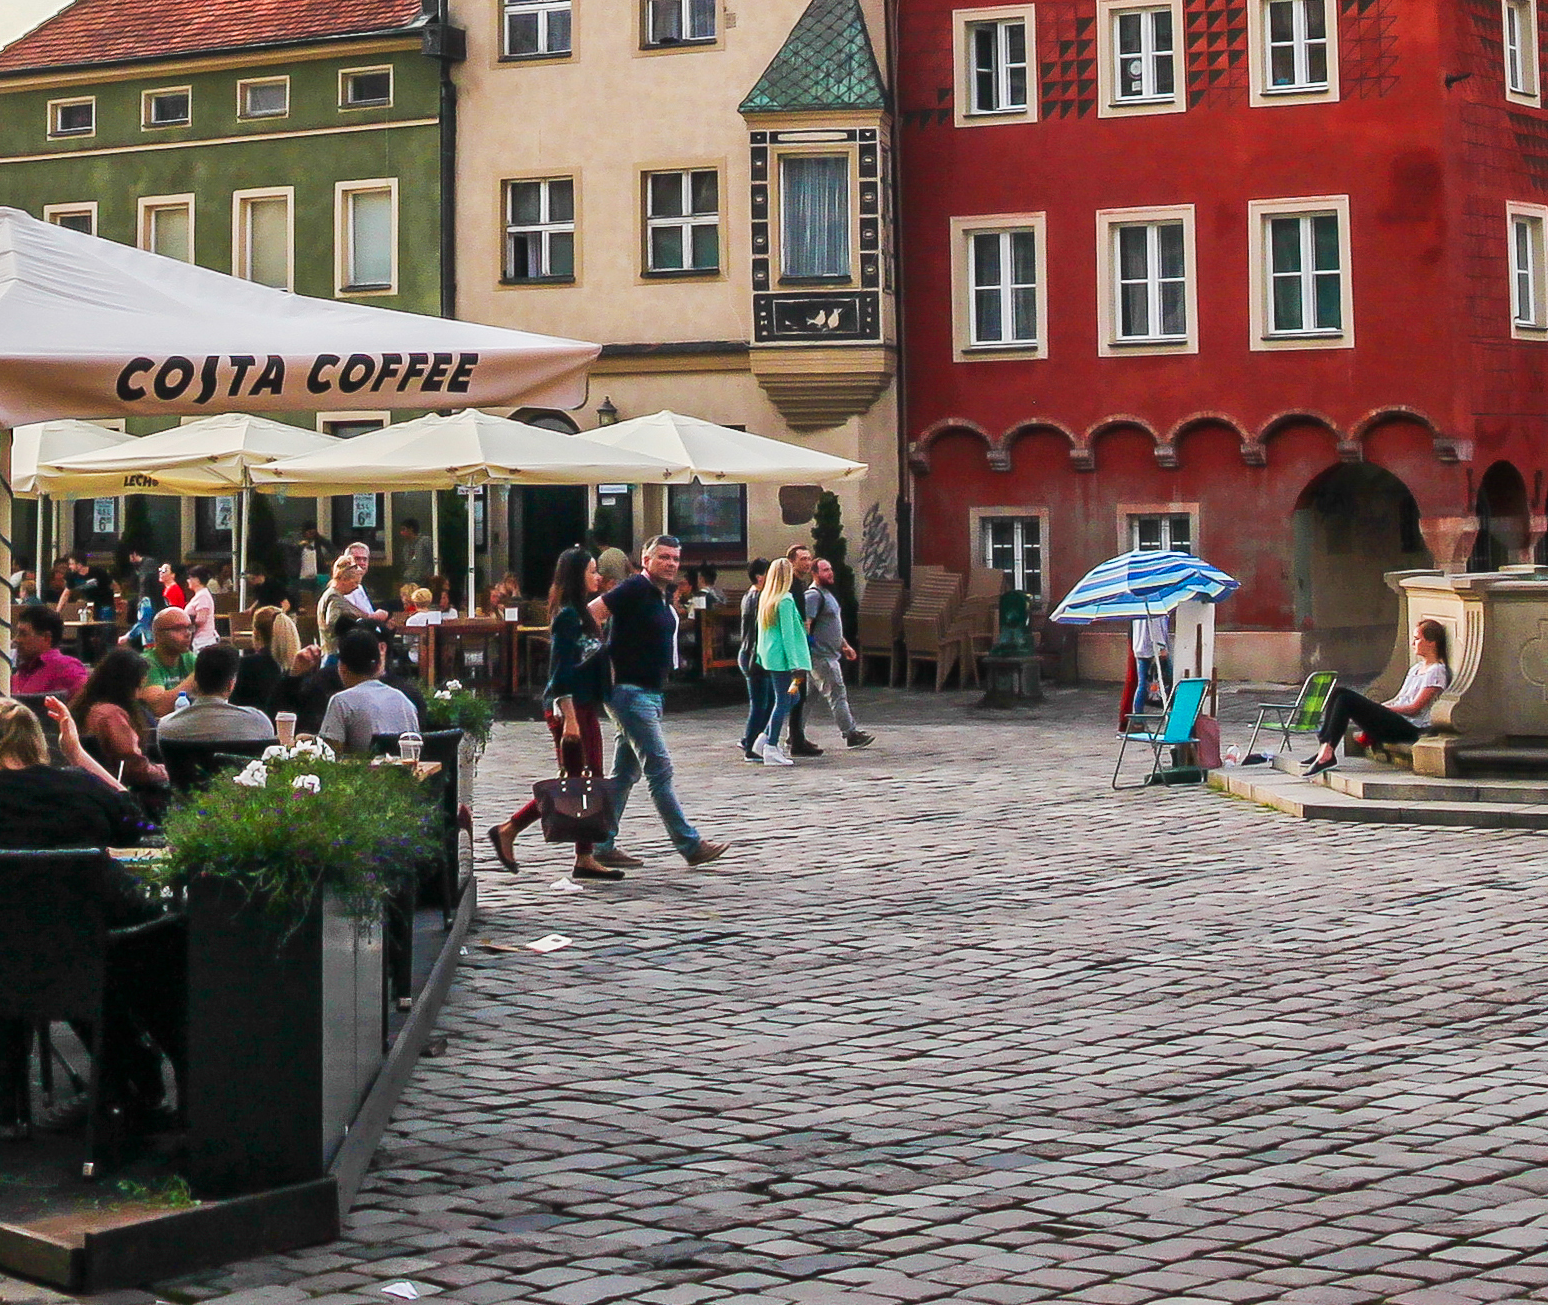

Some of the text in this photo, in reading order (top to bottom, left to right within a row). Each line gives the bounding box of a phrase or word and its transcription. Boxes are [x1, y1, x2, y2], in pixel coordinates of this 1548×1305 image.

[116, 352, 479, 405] COSTA COFFEE
[123, 476, 153, 487] LECH
